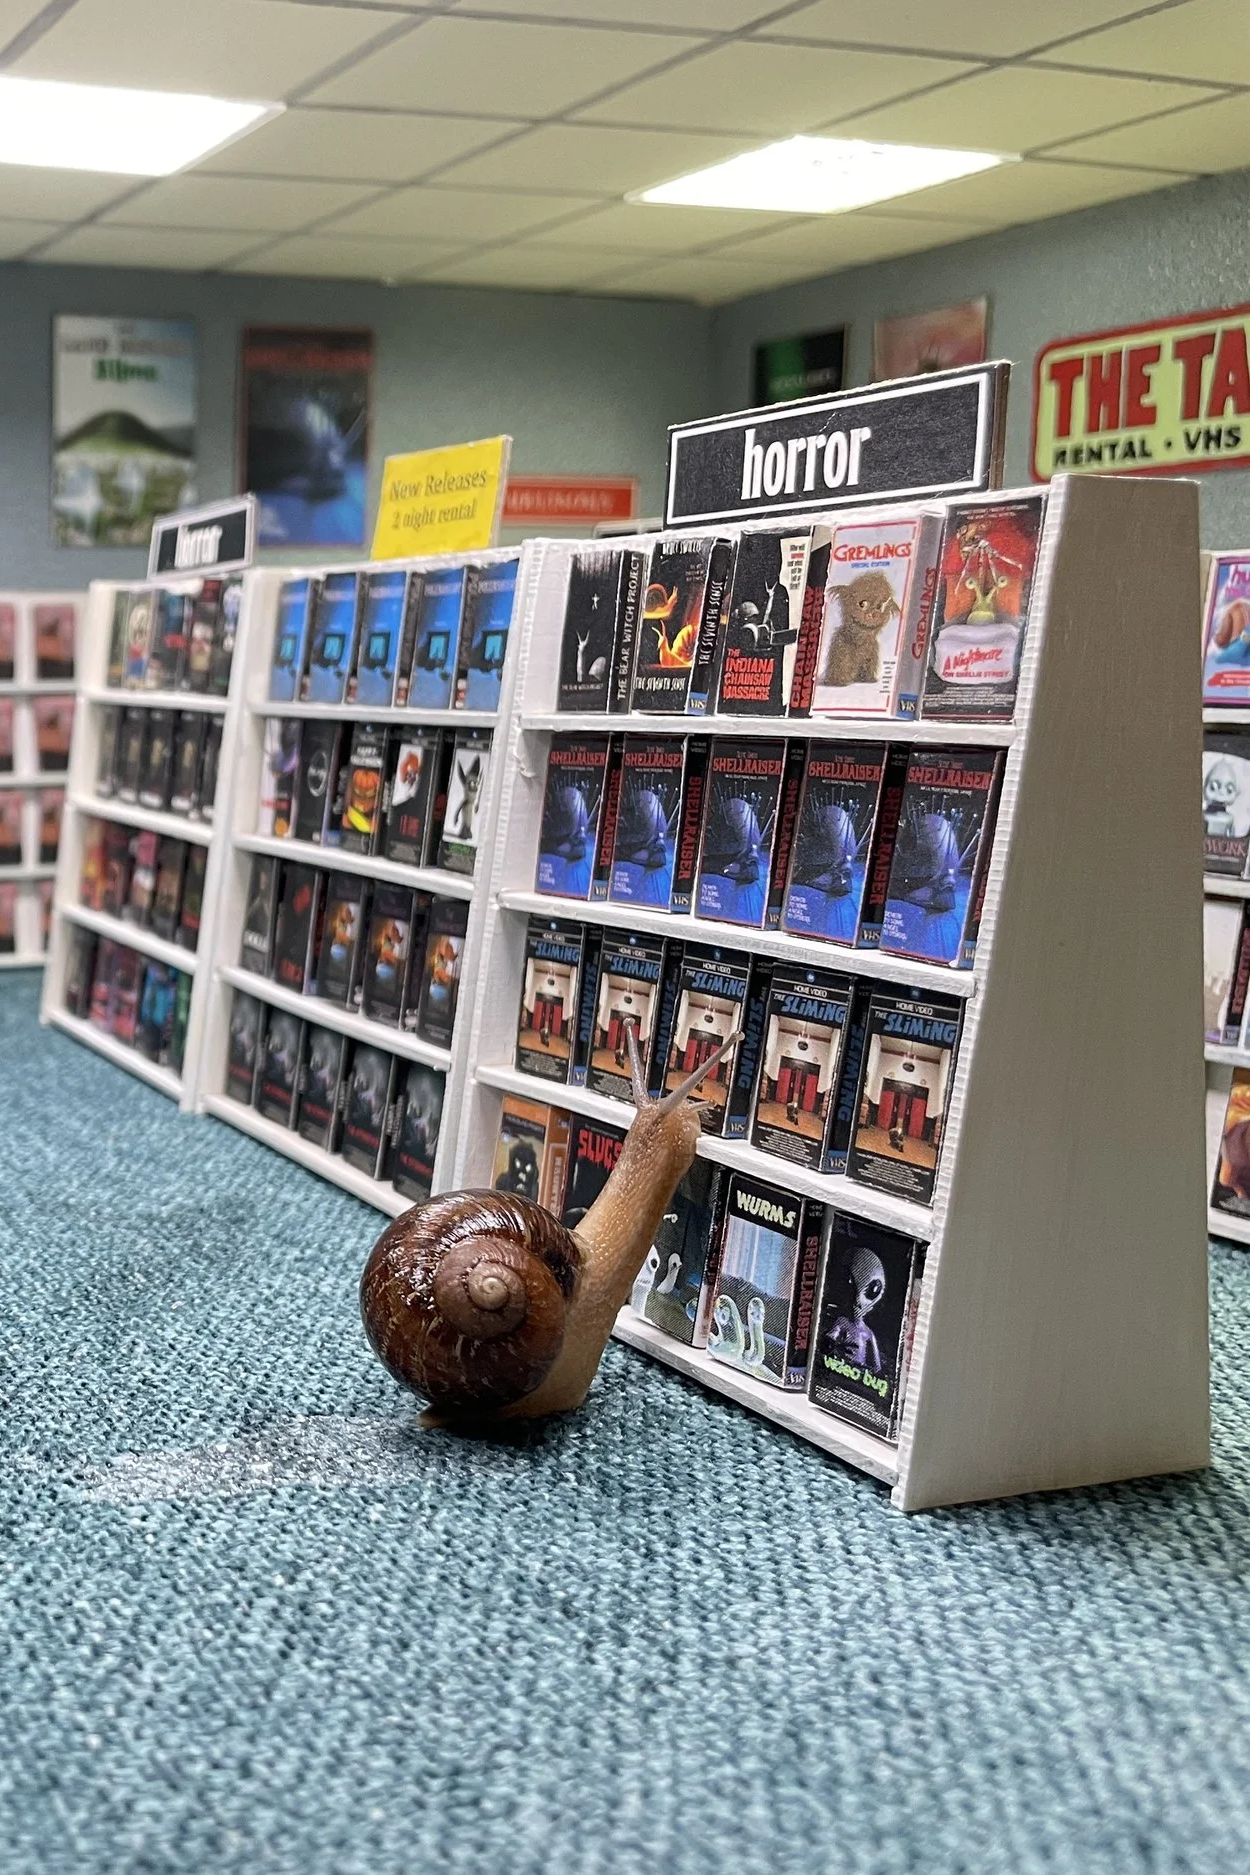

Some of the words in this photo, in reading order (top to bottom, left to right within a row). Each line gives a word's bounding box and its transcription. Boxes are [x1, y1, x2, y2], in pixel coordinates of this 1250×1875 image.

[1049, 344, 1161, 439] THE
[1053, 440, 1153, 467] RENTAL
[1183, 427, 1241, 453] VHS
[740, 426, 872, 501] horror
[390, 479, 421, 500] New
[424, 470, 487, 497] Releases
[392, 511, 401, 530] 2
[403, 506, 437, 532] night
[438, 499, 477, 522] rental
[833, 543, 913, 562] GREMLINGS
[626, 555, 640, 603] PROJECT
[622, 605, 635, 643] WITCH
[911, 567, 937, 661] GREMLINGS
[789, 586, 815, 709] CHAINSAW
[799, 586, 825, 709] MASSACRE
[953, 647, 1004, 672] Nightmare
[725, 657, 775, 673] INDIANA
[983, 669, 1009, 678] STREET
[617, 677, 628, 701] THE
[724, 671, 773, 686] CHAINSAW
[723, 685, 770, 700] MASSACRE
[549, 751, 608, 766] SHELLRAISER
[713, 757, 782, 775] SHELLRAISER
[808, 761, 883, 783] SHELLRAISER
[908, 766, 991, 790] SHELLRAISER
[677, 776, 703, 880] SHELLRAISER
[773, 779, 799, 890] SHELLRAISER
[869, 786, 901, 906] SHELLRAISER
[673, 895, 689, 905] VHS
[862, 930, 880, 941] VHS
[702, 962, 717, 972] HOME
[716, 964, 731, 974] VIDEO
[773, 993, 785, 1001] THE
[793, 985, 810, 995] HOME
[810, 987, 828, 998] VIDEO
[874, 1010, 887, 1020] THE
[896, 1002, 914, 1012] HOME
[914, 1005, 933, 1016] VIDEO
[731, 1122, 745, 1133] VHS
[830, 1156, 846, 1169] VHS
[736, 1189, 796, 1228] WURMS
[795, 1234, 820, 1350] SHELLRAISER
[824, 1354, 860, 1381] video
[862, 1368, 888, 1397] bug
